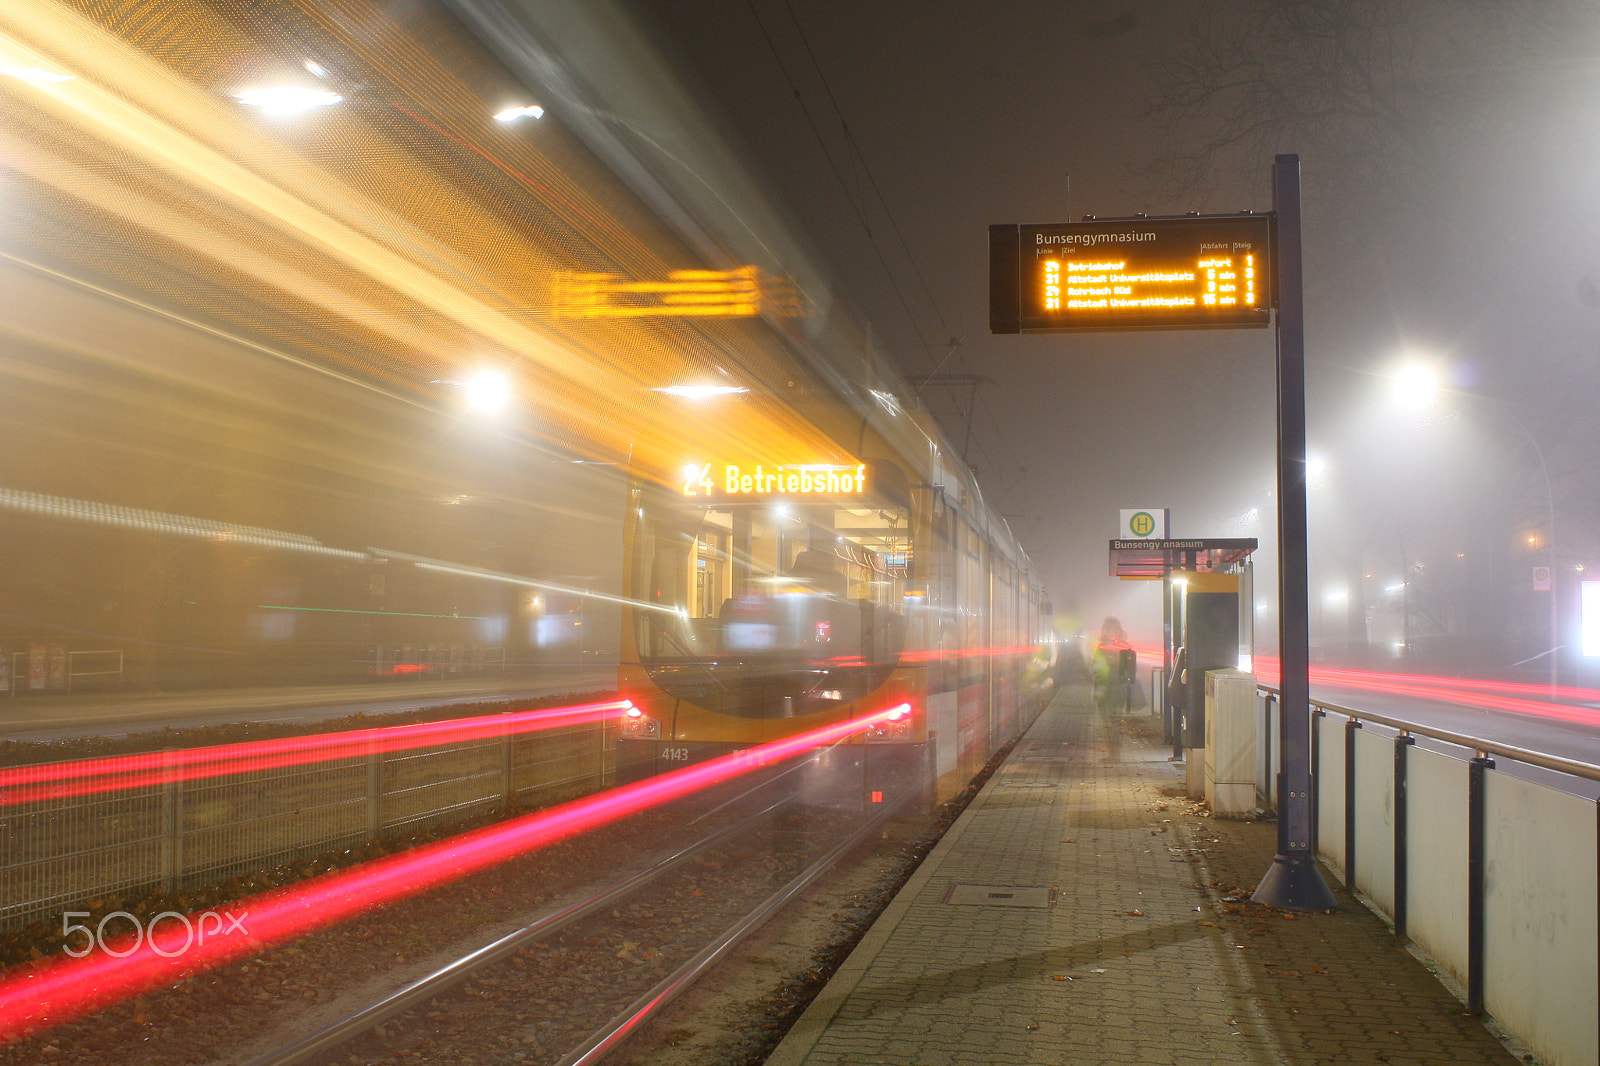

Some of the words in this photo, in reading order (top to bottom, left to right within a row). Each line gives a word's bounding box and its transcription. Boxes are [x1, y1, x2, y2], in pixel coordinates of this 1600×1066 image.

[1036, 230, 1156, 246] Bunsengymnasium
[1068, 261, 1126, 272] Betriebshof
[1198, 259, 1232, 268] sofort
[1246, 255, 1253, 267] 1
[1045, 273, 1059, 284] 31
[1245, 268, 1254, 279] 3
[1246, 280, 1253, 291] 1
[1045, 298, 1060, 309] 31
[1246, 292, 1254, 304] 3
[683, 462, 715, 497] 24
[725, 463, 866, 495] Betriebshof
[1136, 517, 1149, 532] H
[661, 747, 689, 761] 4143
